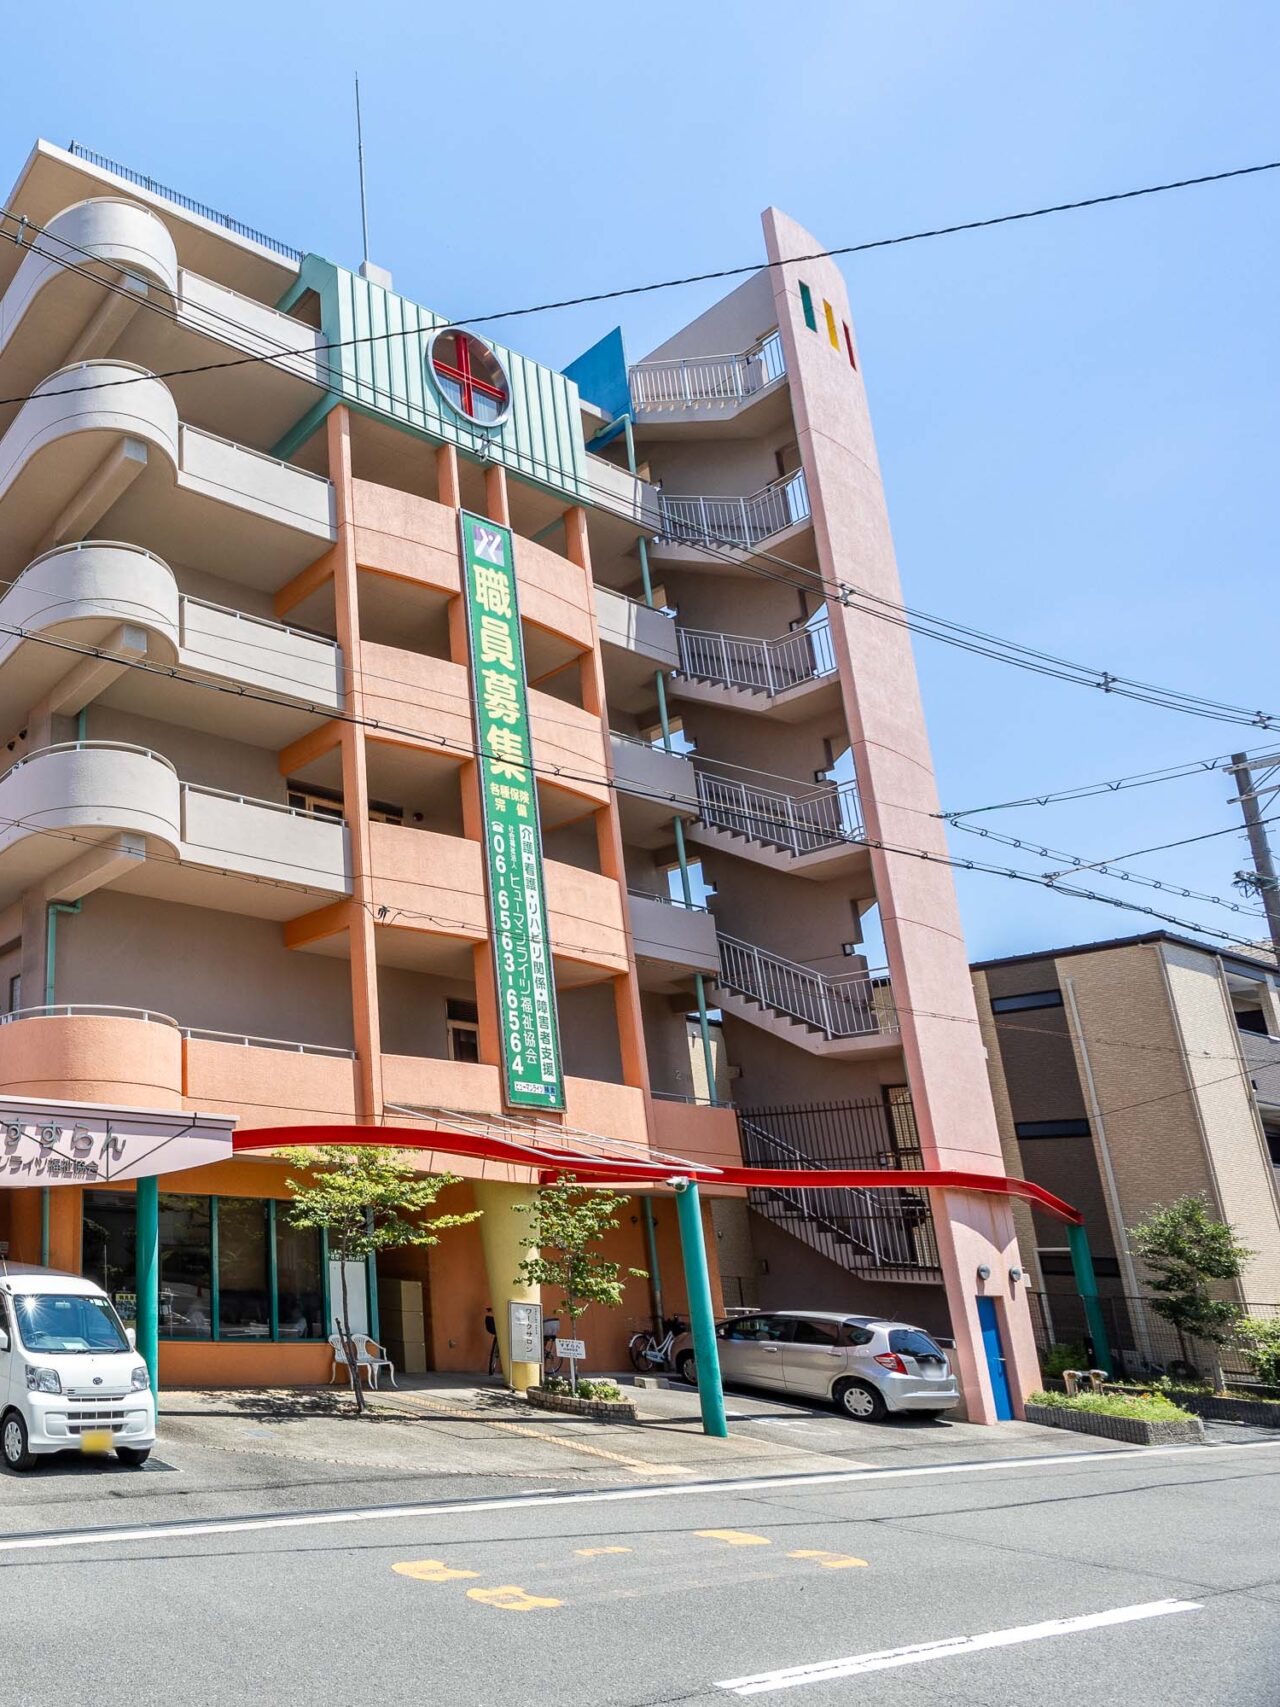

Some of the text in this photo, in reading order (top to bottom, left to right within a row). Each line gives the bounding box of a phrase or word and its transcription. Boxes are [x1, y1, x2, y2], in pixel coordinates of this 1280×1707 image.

[472, 564, 527, 783] 職員募集
[489, 782, 530, 804] 各種保険
[492, 834, 524, 1076] 06-6563-6564
[509, 873, 538, 1065] ヒューマンライツ福祉協会
[521, 825, 556, 1079] 介護・看護・リハビリ関係・障害者支援
[525, 1308, 533, 1352] ワークサロン
